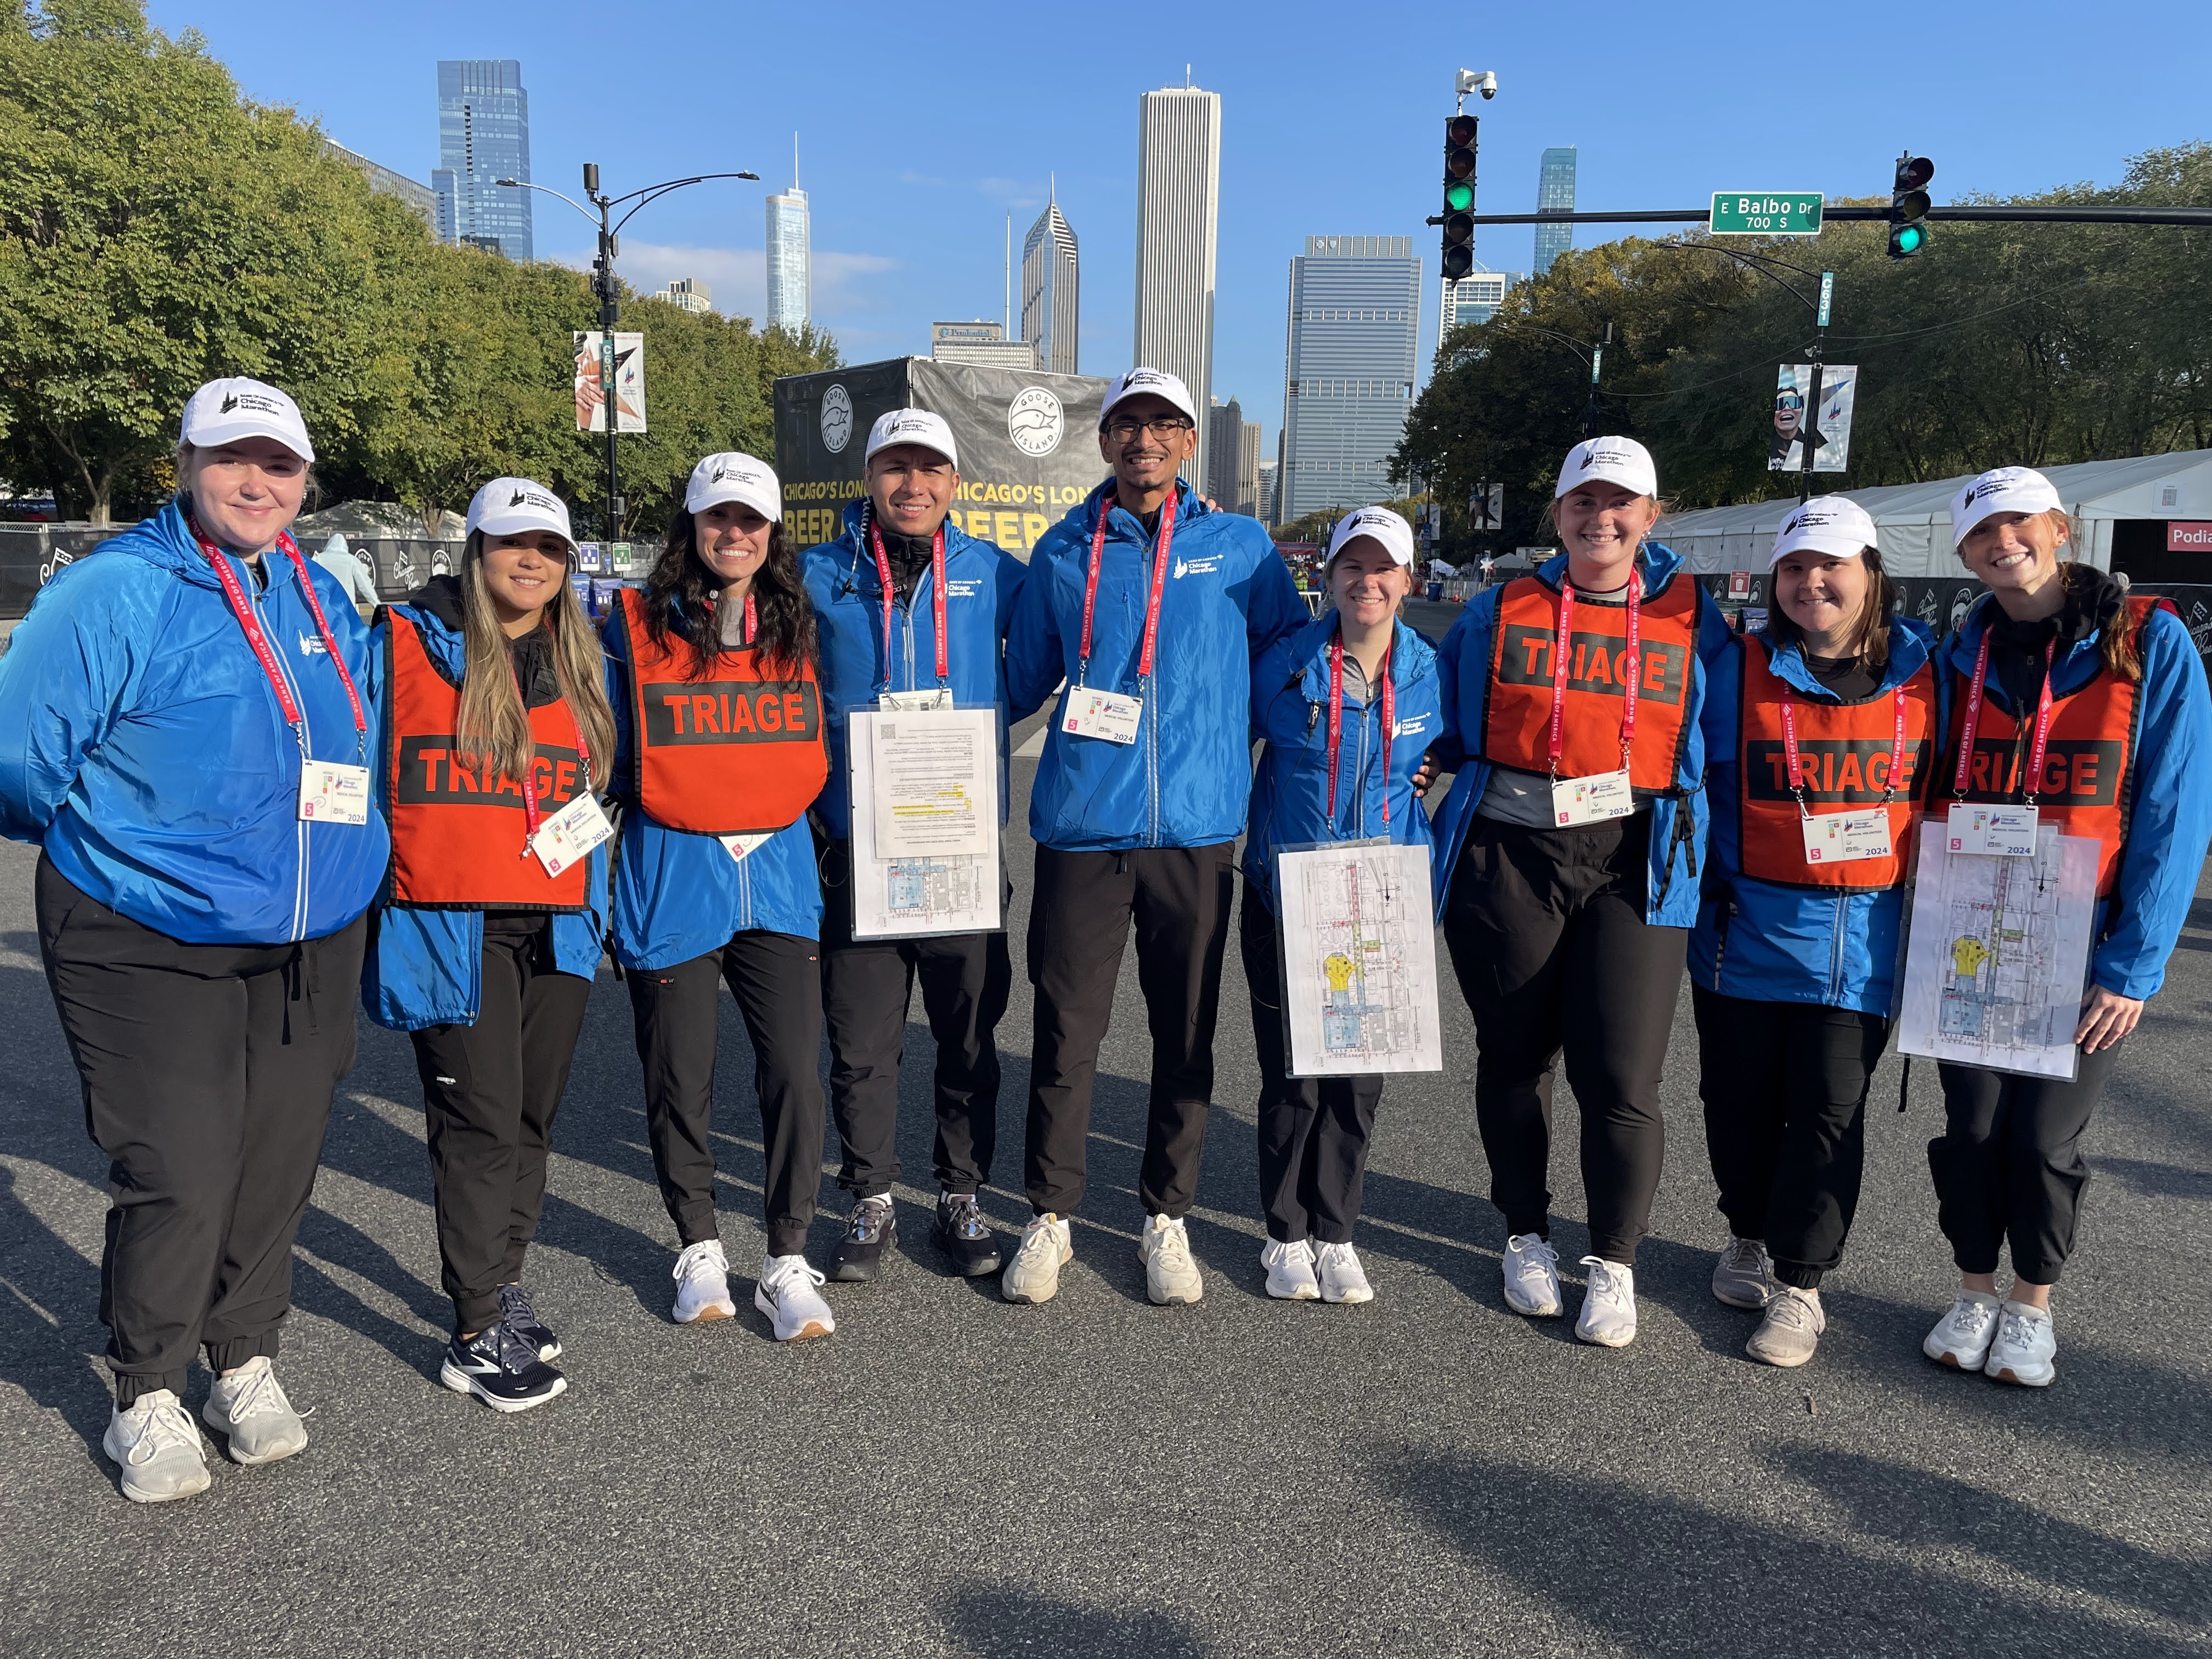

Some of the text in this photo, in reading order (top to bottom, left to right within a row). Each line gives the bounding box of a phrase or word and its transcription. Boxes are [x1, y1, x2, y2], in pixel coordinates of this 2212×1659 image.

[1721, 198, 1812, 214] E Balbo Dr
[1746, 217, 1787, 229] 700 S
[1821, 278, 1831, 321] C631
[603, 345, 612, 383] C630
[240, 399, 272, 408] Chicago
[826, 391, 845, 405] GOOSE
[1021, 394, 1054, 409] GOOSE
[241, 404, 279, 416] Marathon
[826, 431, 847, 447] ISLAND
[1018, 435, 1053, 450] ISLAND
[726, 472, 749, 480] Chicago
[726, 476, 754, 486] Marathon
[784, 481, 837, 501] CHICAGO'S
[957, 482, 1046, 504] HICAGO'S
[1977, 484, 2002, 494] Chicago
[1977, 487, 2009, 499] Marathon
[784, 509, 834, 544] BEER
[1096, 530, 1102, 538] OF
[2174, 529, 2212, 544] Podia
[1161, 531, 1171, 558] AMERICA
[877, 540, 887, 565] AMERICA
[936, 555, 940, 563] OF
[1160, 557, 1165, 567] OF
[882, 564, 888, 573] OF
[215, 555, 250, 615] BANK OF AMERICA
[297, 565, 307, 583] BANK
[305, 584, 311, 593] OF
[309, 594, 324, 625] AMERICA
[1633, 620, 1638, 630] OF
[751, 633, 755, 641] OF
[1977, 662, 1982, 670] OF
[1971, 671, 1980, 699] AMERICA
[663, 693, 806, 735] TRIAGE
[1402, 726, 1425, 736] Marathon
[1897, 733, 1901, 741] OF
[1114, 733, 1133, 742] 2024
[2033, 713, 2048, 772] BANK OF AMERICA
[1791, 744, 1795, 754] OF
[1893, 741, 1901, 770] AMERICA
[1765, 752, 1915, 792] TRIAGE
[526, 782, 535, 816] AMERICA
[307, 805, 313, 815] 5
[1609, 806, 1629, 815] 2024
[348, 814, 365, 822] 2024
[1561, 814, 1567, 822] 5
[592, 827, 610, 844] 2024
[1953, 840, 1960, 848] 5
[735, 847, 742, 855] 5
[1865, 848, 1888, 856] 2024
[2007, 847, 2030, 855] 2024
[551, 861, 560, 871] 5
